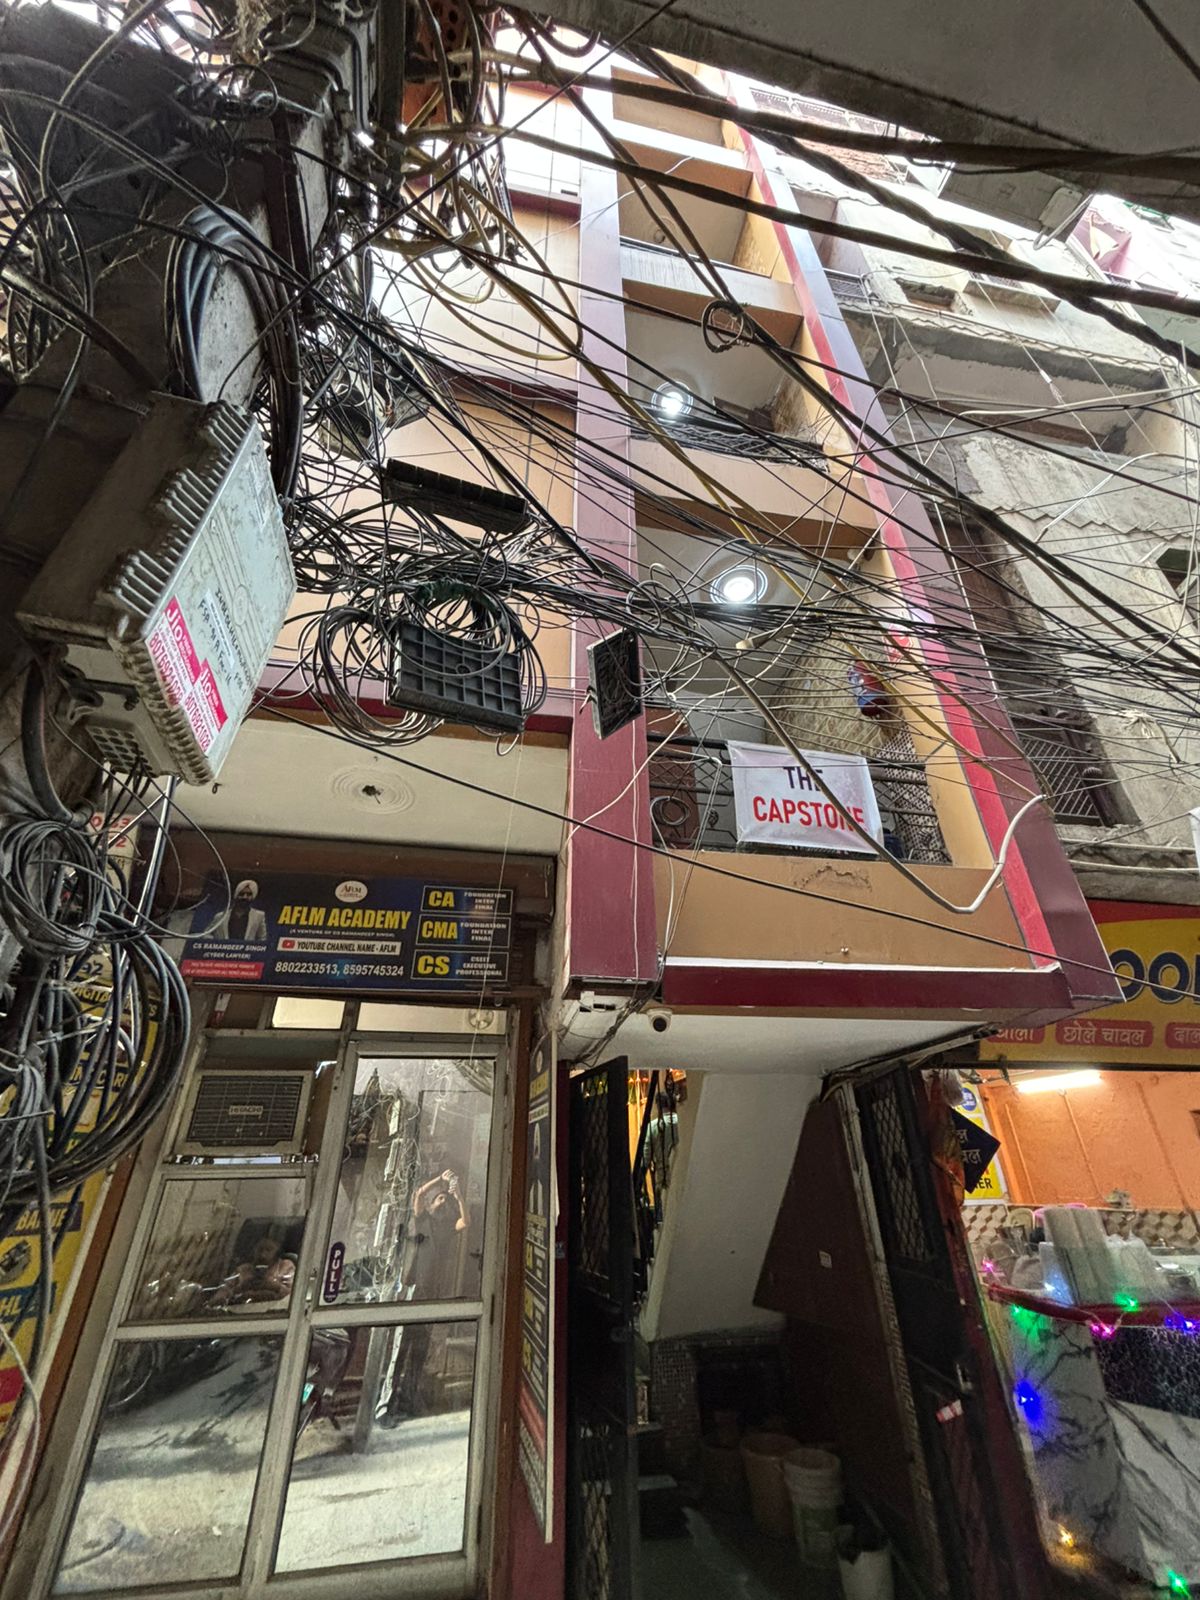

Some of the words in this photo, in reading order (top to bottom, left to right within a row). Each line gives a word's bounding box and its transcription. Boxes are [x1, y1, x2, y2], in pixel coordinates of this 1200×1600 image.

[166, 608, 183, 643] Jio
[199, 667, 213, 697] Jio
[428, 890, 455, 908] CA
[463, 891, 507, 899] FOUNDATION
[277, 905, 327, 926] AFLM
[326, 908, 412, 930] ACADEMY
[421, 920, 458, 939] CMA
[244, 944, 267, 952] SINGH
[297, 940, 325, 951] YOUTUBE
[326, 942, 356, 953] CHANNEL
[356, 943, 375, 953] NAME
[378, 943, 397, 953] AFLM
[342, 962, 405, 977] 8595745324
[416, 955, 450, 976] CS
[1063, 1020, 1098, 1044] छोले
[1101, 1027, 1147, 1046] चावल
[330, 1248, 342, 1293] PULL
